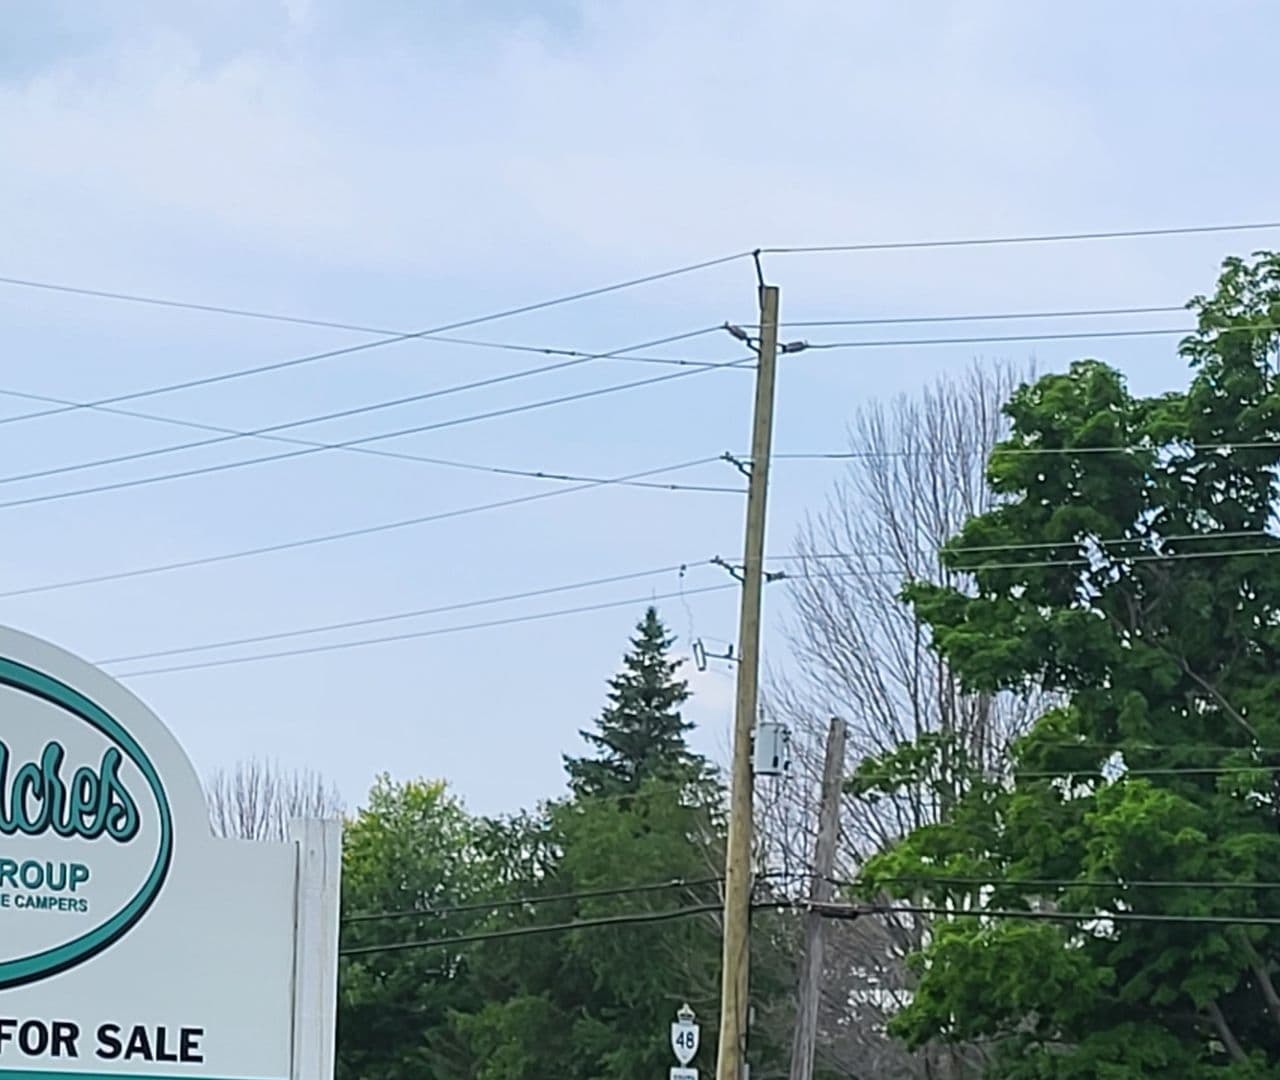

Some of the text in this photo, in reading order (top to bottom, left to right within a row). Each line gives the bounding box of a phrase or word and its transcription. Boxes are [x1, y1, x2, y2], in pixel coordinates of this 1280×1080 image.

[14, 895, 89, 912] CAMPERS
[95, 1023, 204, 1063] SALE
[676, 1031, 696, 1049] 48
